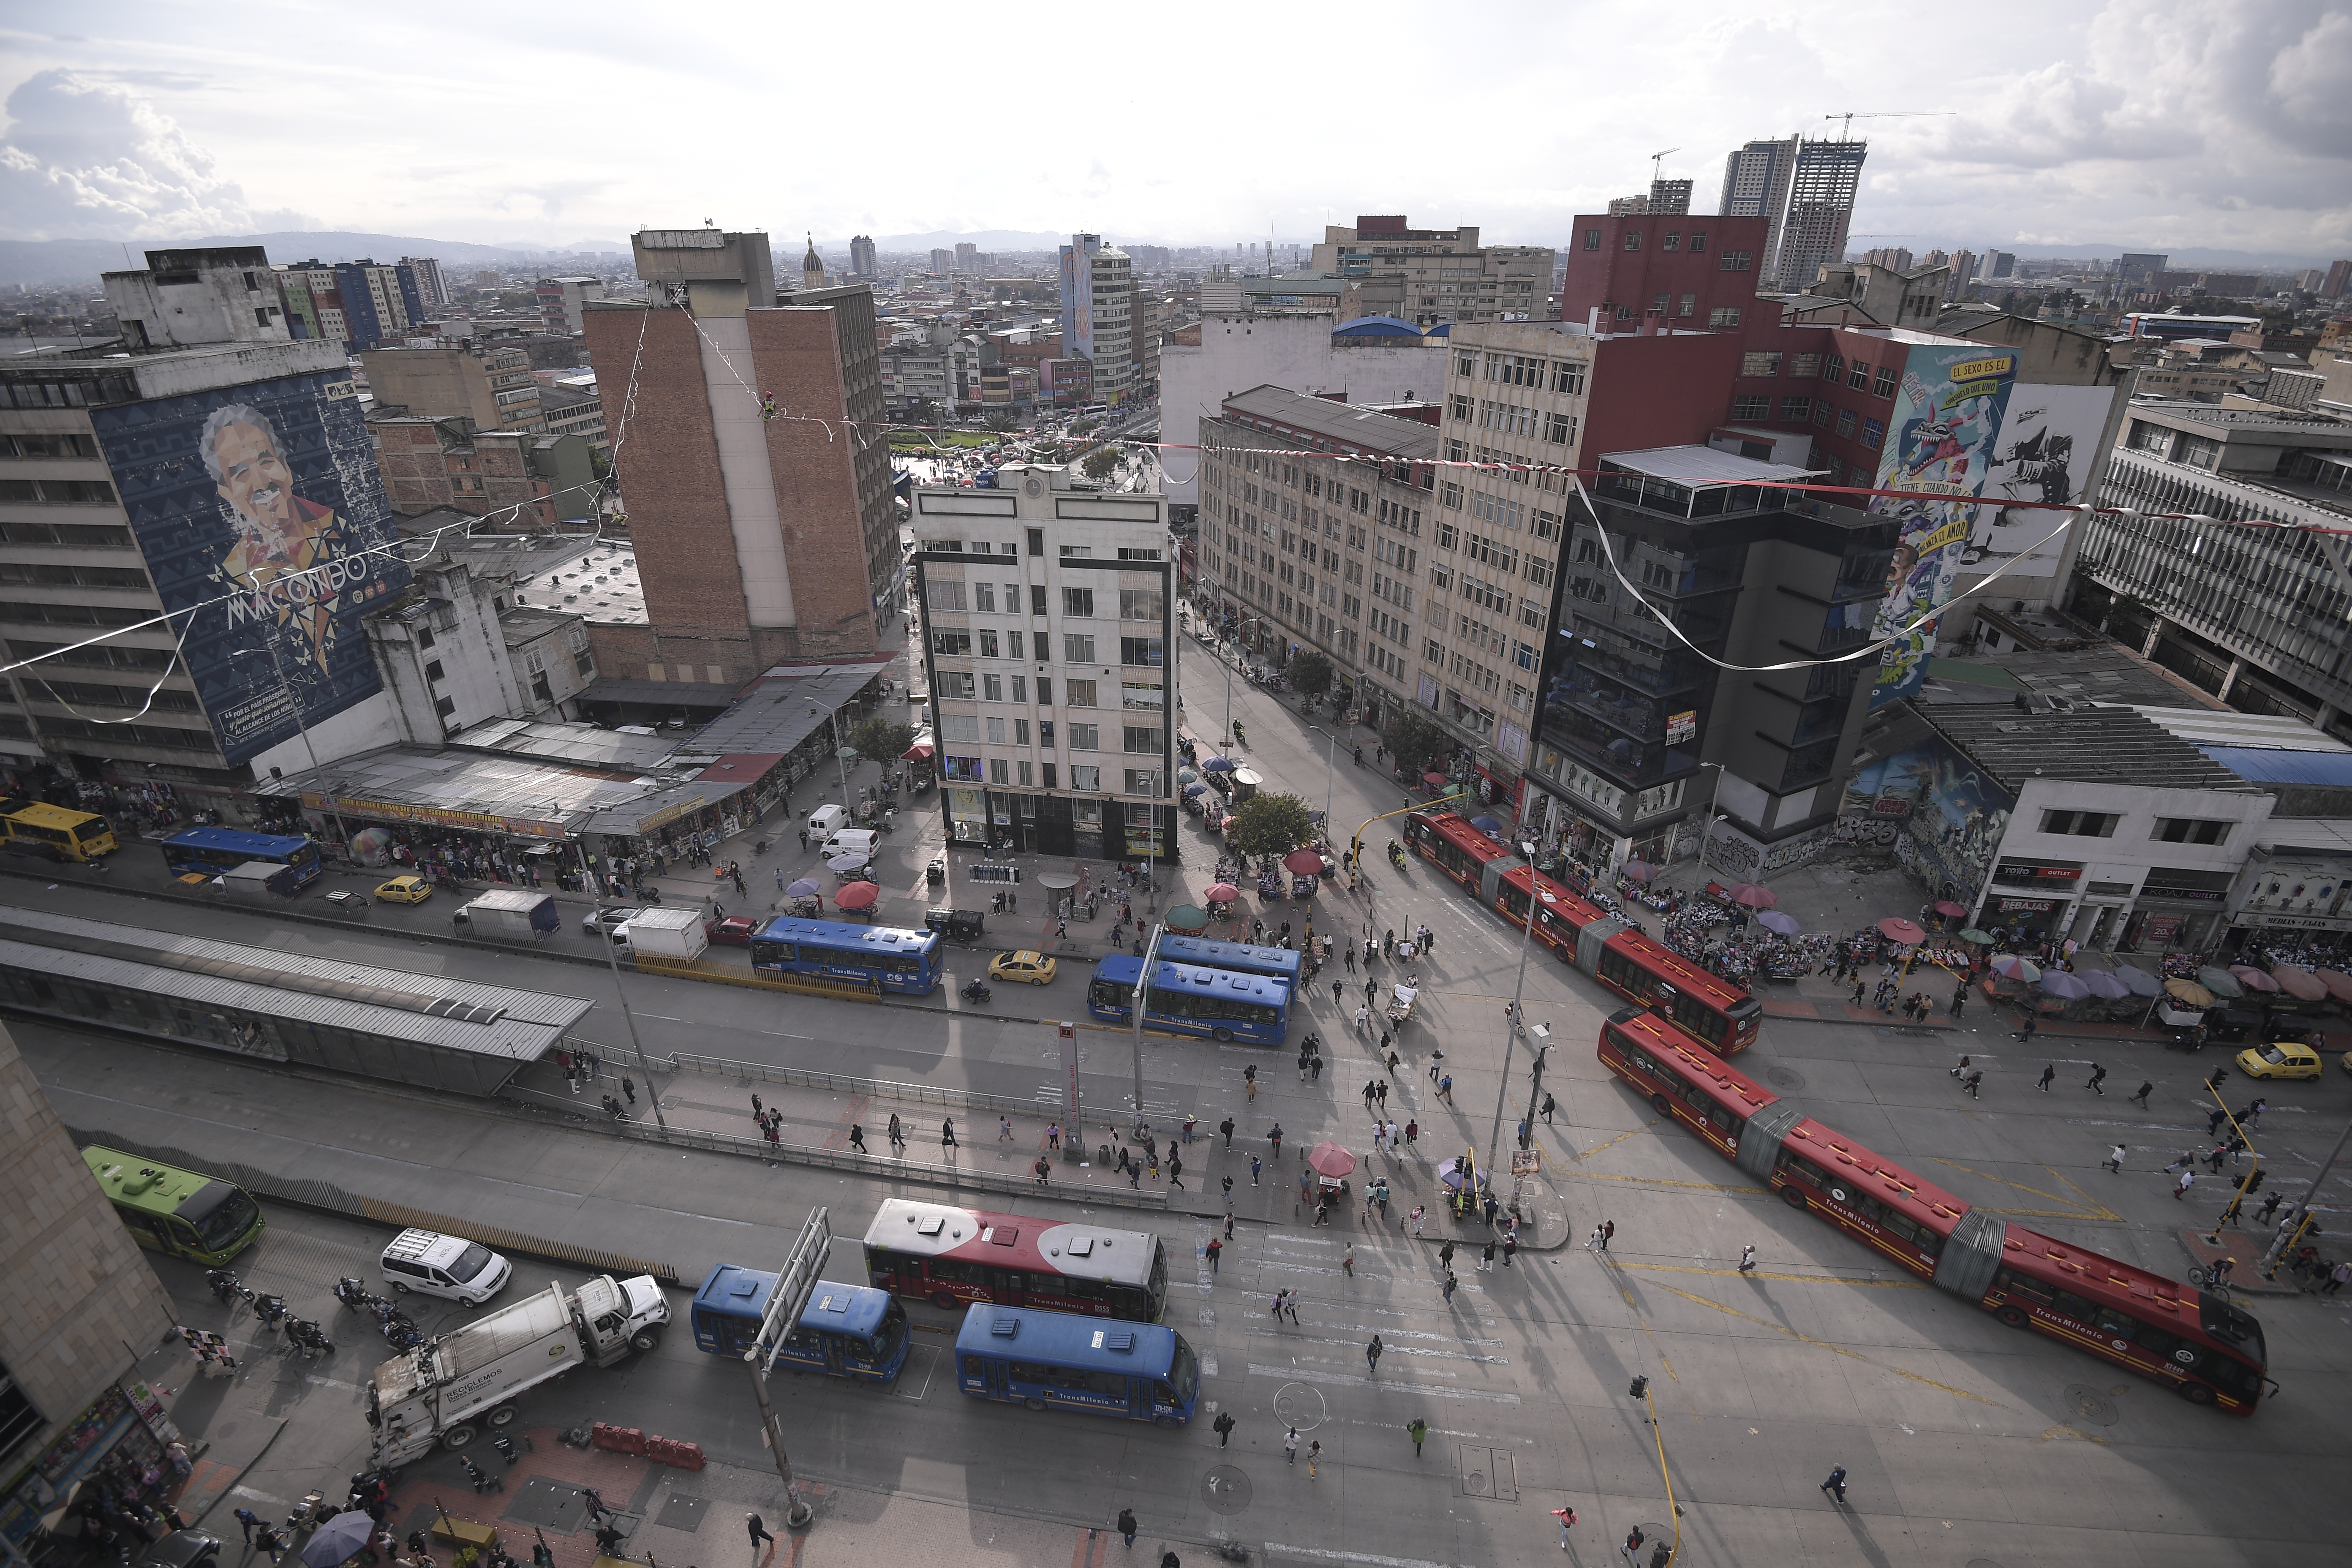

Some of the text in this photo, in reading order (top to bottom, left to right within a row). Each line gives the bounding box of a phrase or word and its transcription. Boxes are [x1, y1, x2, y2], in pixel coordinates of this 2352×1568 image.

[1953, 359, 2005, 377] EL SEXO ES EL
[1901, 371, 1927, 410] PETRA
[1946, 383, 1995, 406] CONSUELO QUE UNO
[1900, 482, 1919, 492] TIENE
[1923, 482, 1949, 494] CUANDO
[1949, 485, 1962, 495] NO
[1920, 522, 1965, 553] ALCANZA EL AMOR
[228, 555, 366, 630] MACONDO
[250, 700, 262, 710] PAÍS
[262, 688, 286, 704] PRÓSPERO
[1364, 679, 1400, 705] Joy Star
[229, 721, 235, 731] y
[251, 708, 264, 720] que
[263, 696, 289, 713] soñamos
[235, 727, 242, 735] AL
[242, 717, 264, 733] ALCANCE
[271, 709, 280, 719] LOS
[281, 702, 295, 714] NIÑO
[239, 736, 249, 744] ARTE
[251, 729, 264, 738] CIENCIA
[274, 715, 291, 727] EDUCACIÓN
[681, 796, 704, 808] PARQUEADERO
[377, 803, 425, 814] COMERCIAL
[450, 811, 501, 823] VICTORINO
[655, 811, 675, 822] ESCOLAR
[2005, 867, 2030, 875] TOTTO
[2149, 888, 2184, 897] KOAJ
[2001, 901, 2050, 911] REBAJAS
[1541, 925, 1568, 947] TransMilenio
[832, 968, 866, 977] TransMilenio
[1171, 1017, 1211, 1028] TransMilenio
[1826, 1198, 1879, 1233] TransMilenio
[1034, 1298, 1084, 1309] TransMilenio
[2036, 1307, 2102, 1339] TransMilenio
[2165, 1362, 2184, 1373] K1449
[446, 1369, 502, 1398] RECICLEMOS
[448, 1379, 491, 1402] Bolsa Blanca
[467, 1382, 493, 1395] recicladores
[1059, 1393, 1109, 1405] TransMilenio
